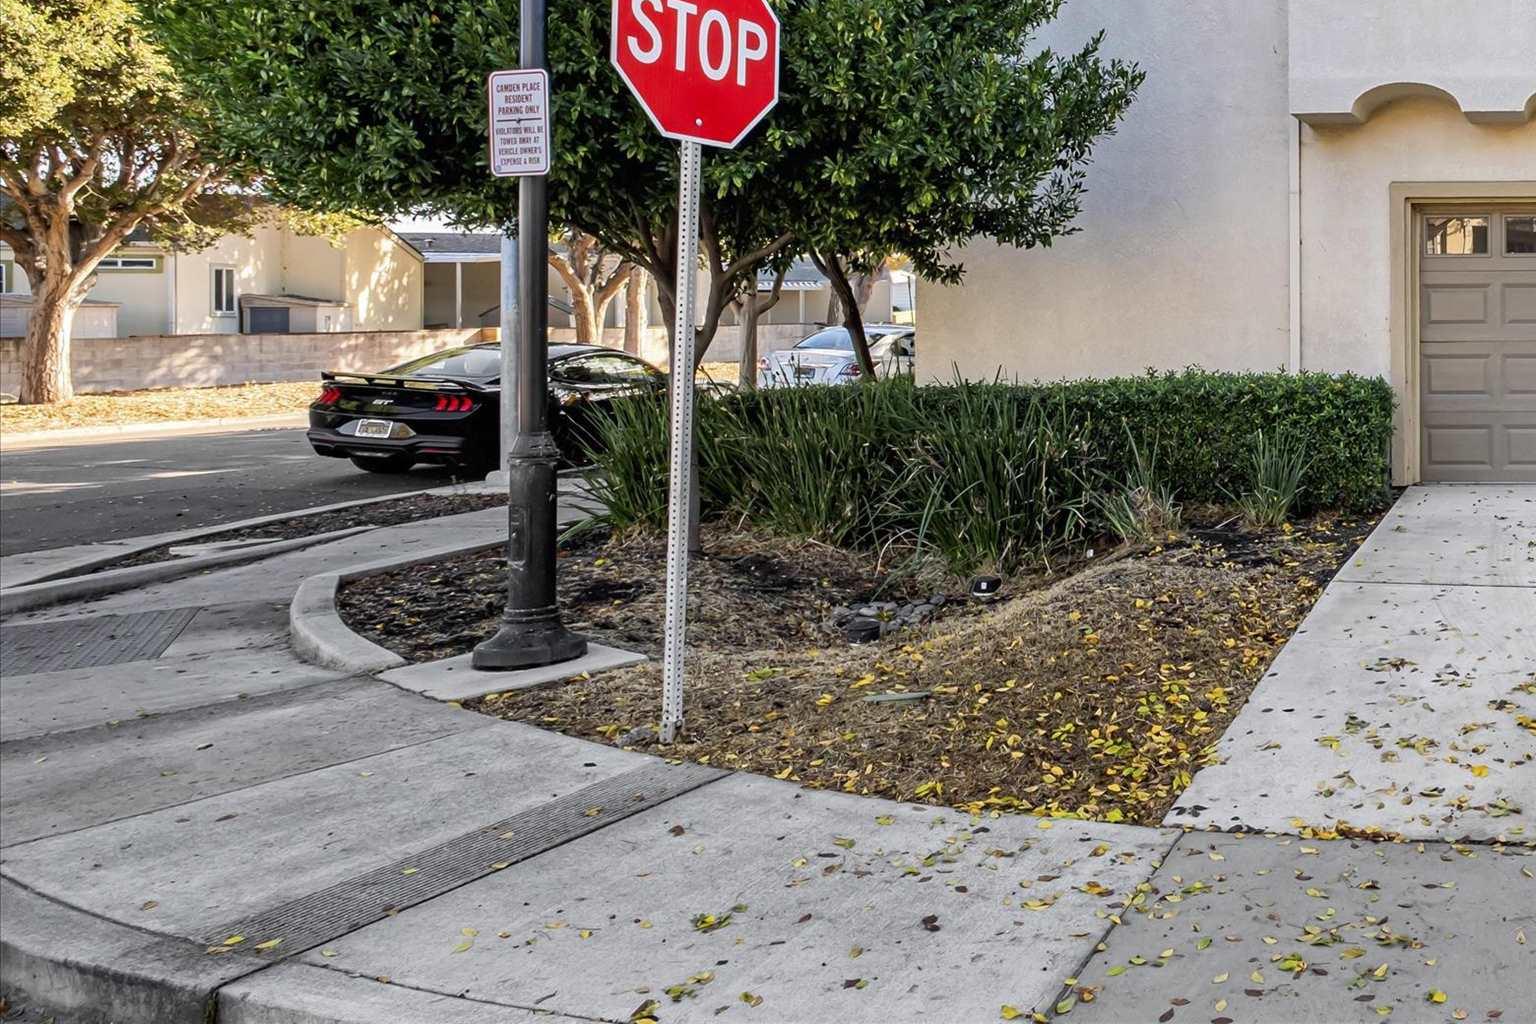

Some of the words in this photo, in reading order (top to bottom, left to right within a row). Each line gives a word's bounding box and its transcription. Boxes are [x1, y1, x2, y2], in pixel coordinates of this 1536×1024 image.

[496, 83, 520, 93] CAMDEN
[522, 82, 541, 92] PLACE
[504, 94, 532, 104] RESIDENT
[498, 106, 523, 115] PARKING
[525, 105, 540, 114] ONLY
[523, 126, 536, 134] WILL
[500, 137, 517, 145] TOWED
[519, 137, 532, 145] AWAY
[533, 136, 540, 144] AT
[498, 148, 518, 156] VEHICLE
